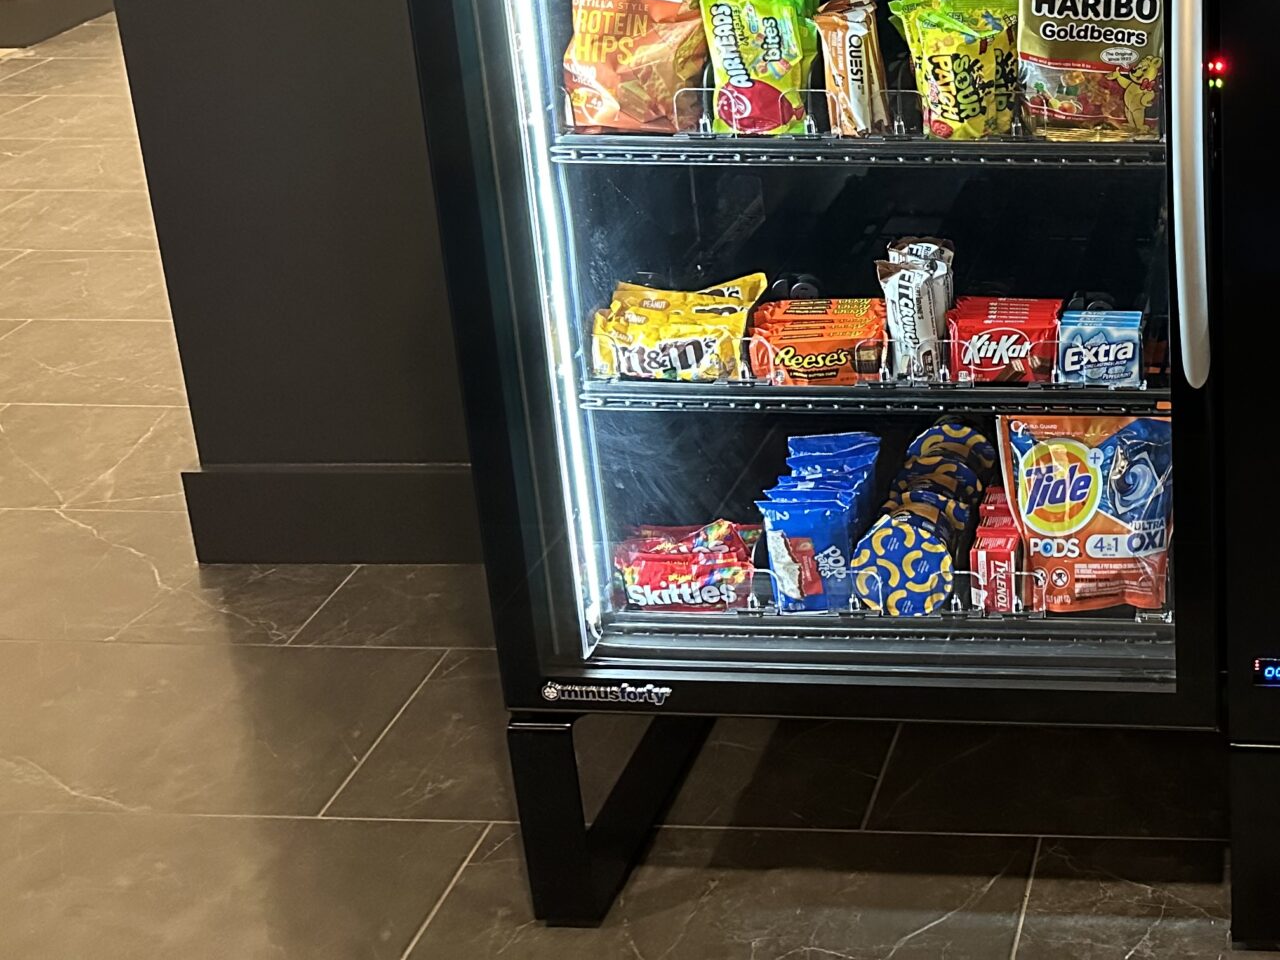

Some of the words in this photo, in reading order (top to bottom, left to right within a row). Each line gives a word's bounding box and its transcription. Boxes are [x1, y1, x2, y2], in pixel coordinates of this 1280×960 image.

[618, 2, 650, 11] STYLE
[709, 3, 755, 88] AIRHEADS
[760, 16, 782, 62] bites
[1040, 21, 1148, 46] Goldbears
[848, 34, 864, 85] QUEST
[928, 54, 960, 122] PATCH
[952, 54, 982, 119] SOUR
[898, 270, 915, 299] FIT
[624, 312, 646, 324] PEANUT
[642, 300, 667, 310] PEANUT
[774, 346, 849, 369] Reese's
[1064, 342, 1134, 372] Extra
[1025, 463, 1093, 515] Tide
[1134, 519, 1164, 531] ULTRA
[1030, 537, 1083, 558] PODS
[1093, 537, 1105, 552] 4
[1112, 537, 1119, 552] 1
[1127, 528, 1165, 554] OXI
[627, 580, 738, 606] Skittles
[995, 560, 1010, 612] TYLENOL
[560, 685, 670, 706] minusforty
